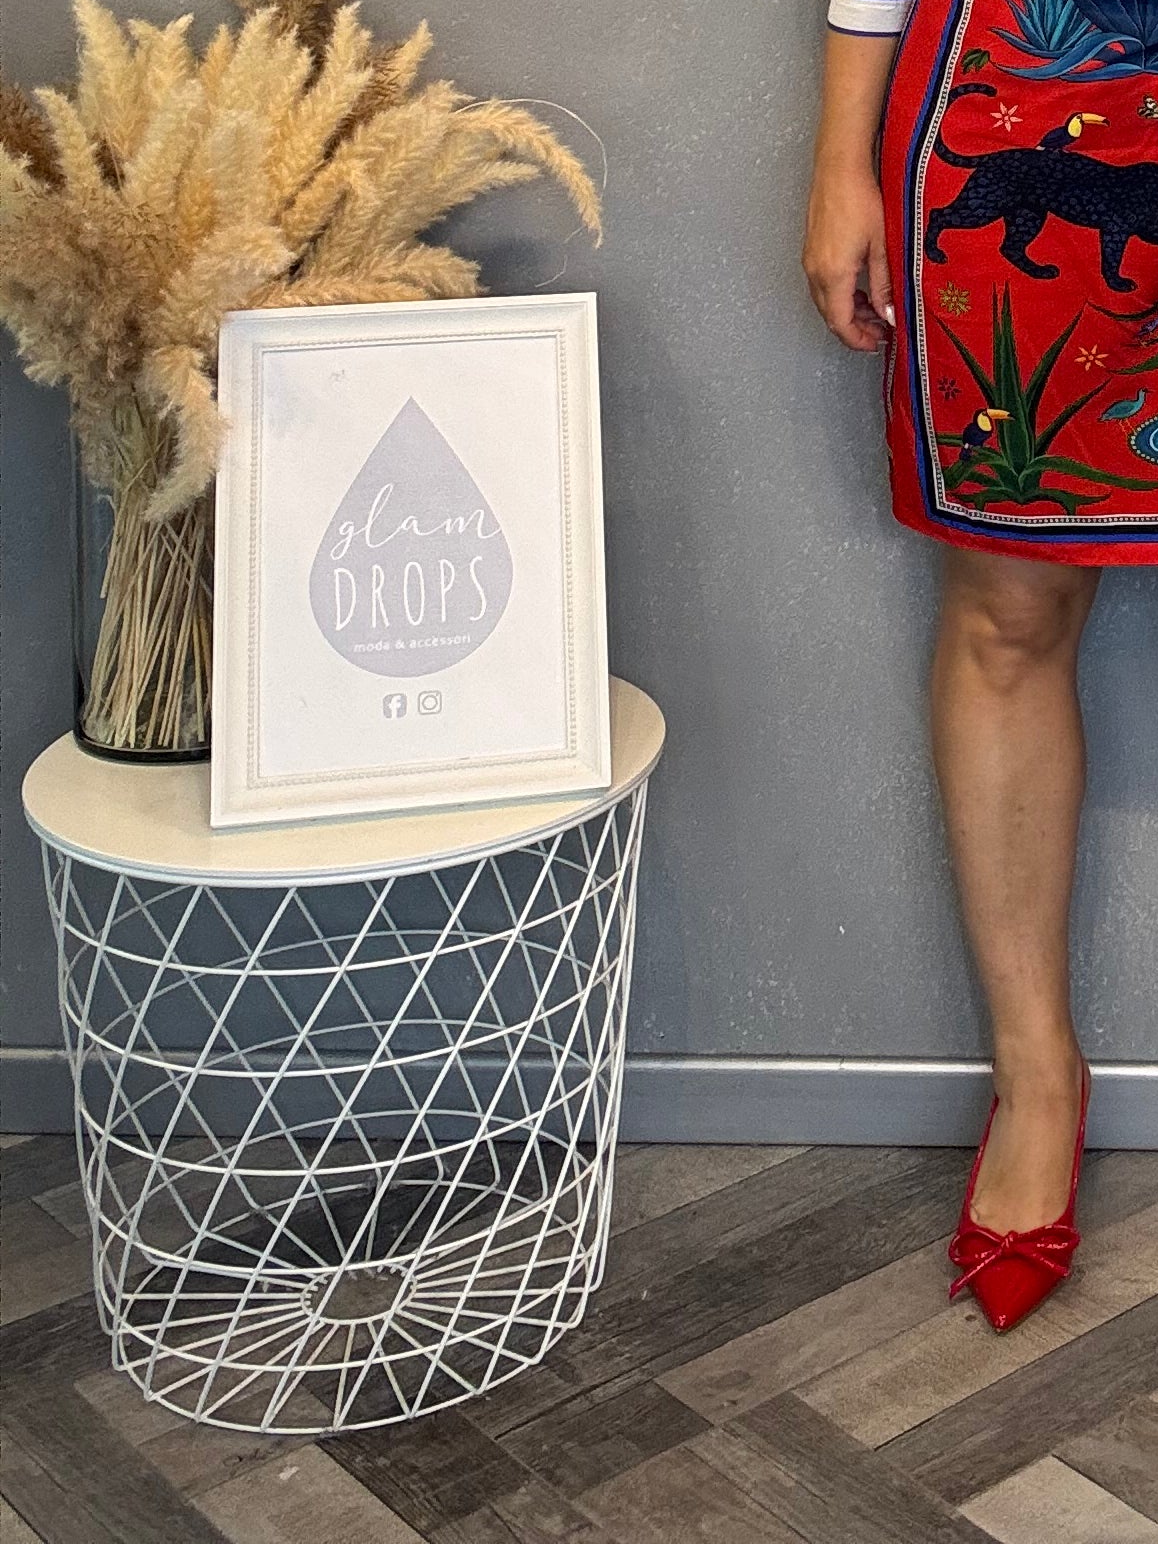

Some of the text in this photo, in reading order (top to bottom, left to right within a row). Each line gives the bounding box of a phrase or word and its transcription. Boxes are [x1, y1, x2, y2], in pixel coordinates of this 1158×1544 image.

[330, 483, 501, 560] glam
[333, 556, 488, 631] DROPS
[353, 640, 390, 653] moda
